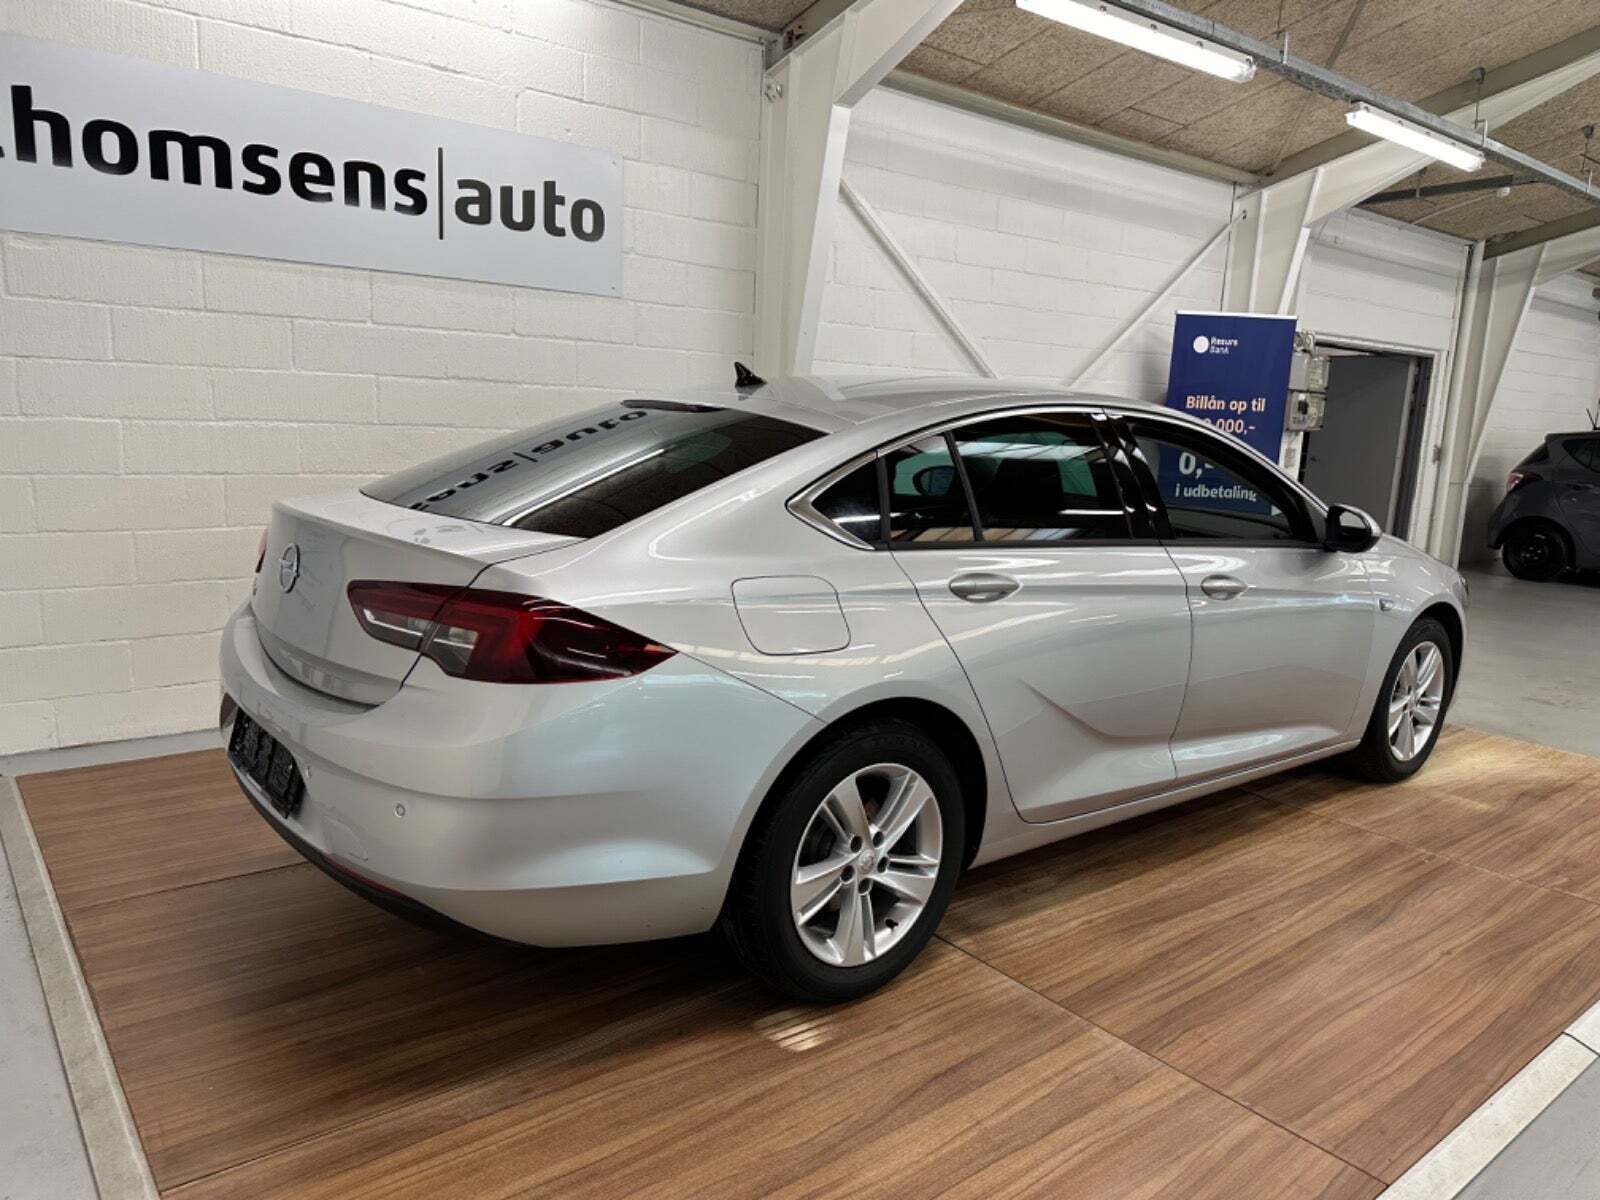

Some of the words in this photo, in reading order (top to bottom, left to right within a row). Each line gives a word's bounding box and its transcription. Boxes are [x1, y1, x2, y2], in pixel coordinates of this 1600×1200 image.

[0, 85, 428, 216] homsens
[1186, 395, 1225, 409] Billån
[1229, 400, 1247, 415] op
[1251, 398, 1266, 412] til
[1175, 483, 1180, 497] i
[1183, 484, 1257, 502] udbetaling
